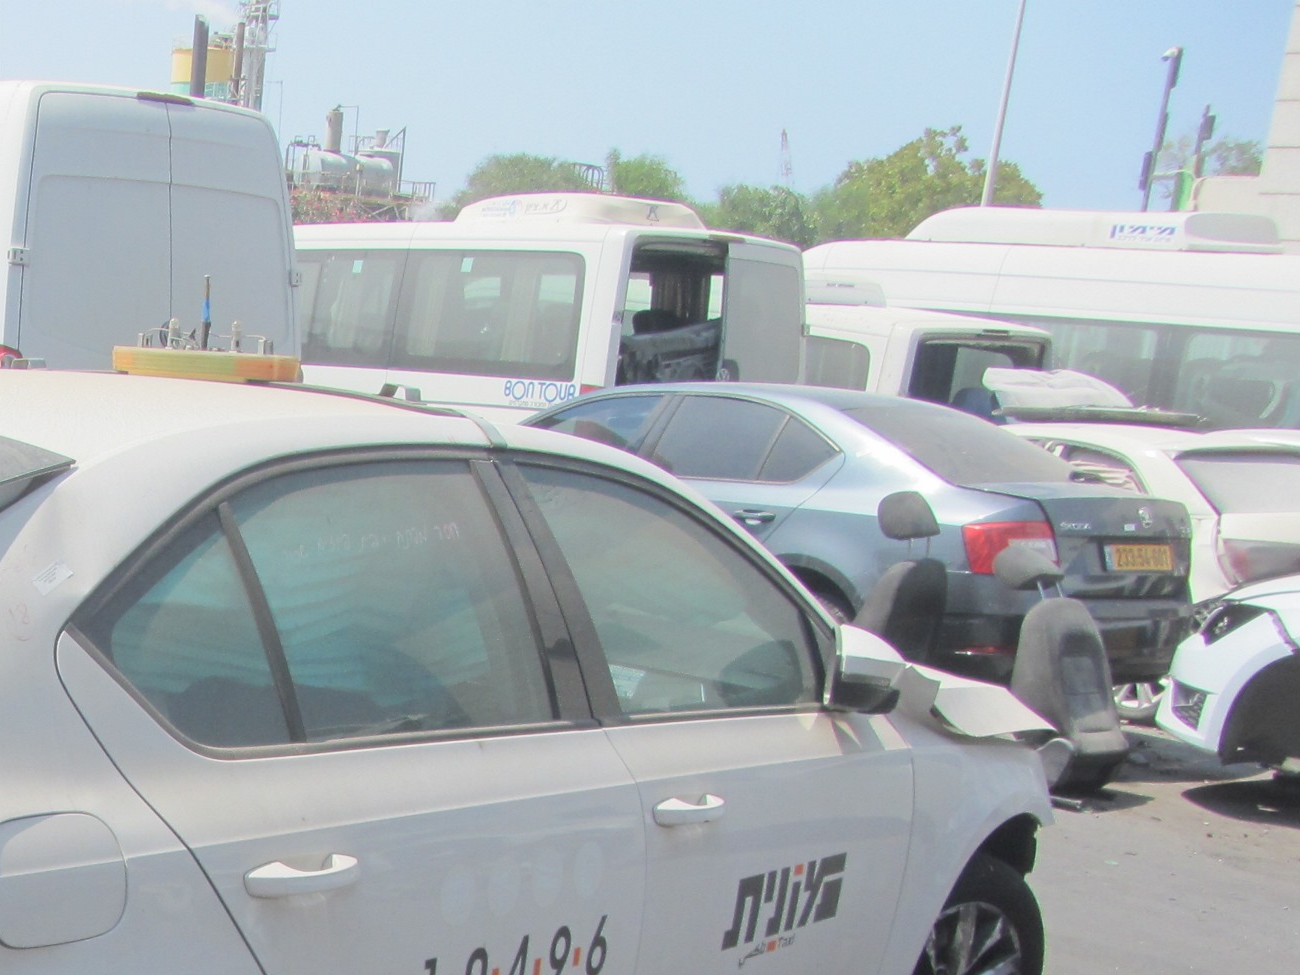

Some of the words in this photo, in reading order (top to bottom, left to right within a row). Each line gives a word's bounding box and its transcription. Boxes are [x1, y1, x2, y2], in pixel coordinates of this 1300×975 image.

[504, 380, 535, 401] BON
[537, 382, 576, 403] TOUR
[721, 852, 847, 951] מונית
